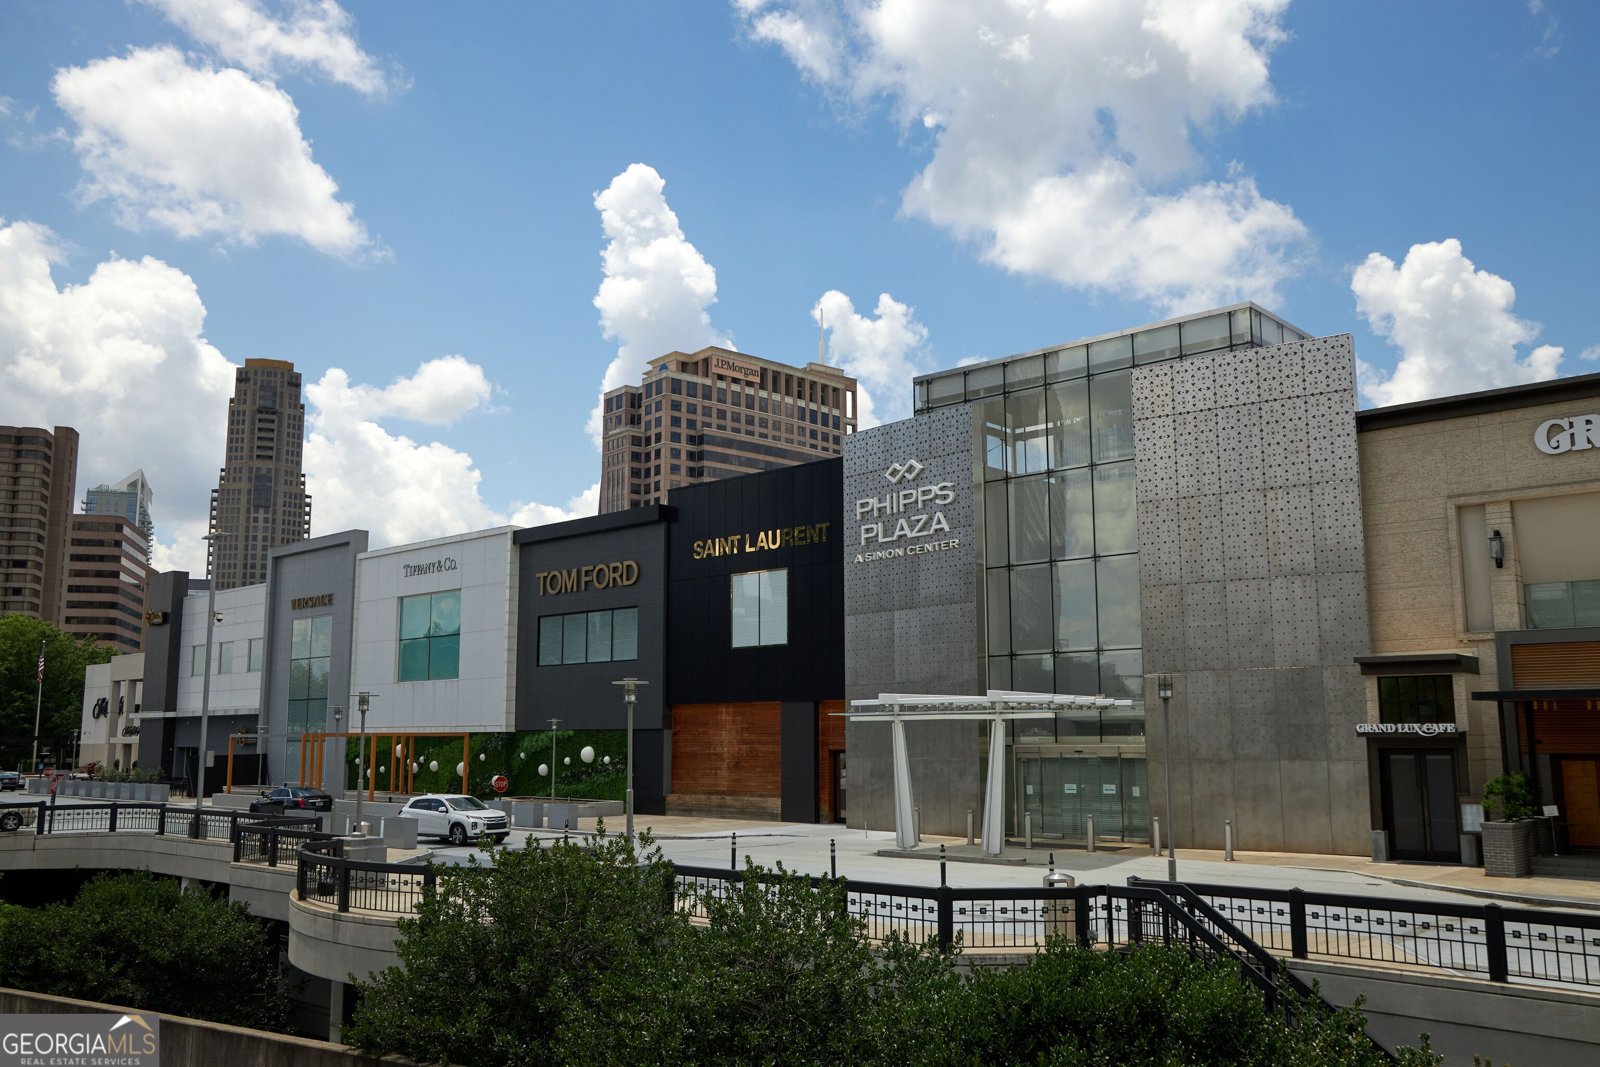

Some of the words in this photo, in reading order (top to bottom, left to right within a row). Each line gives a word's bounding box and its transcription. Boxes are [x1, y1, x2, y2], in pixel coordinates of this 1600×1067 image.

[856, 482, 956, 520] PHIPPS
[692, 535, 741, 560] SAINT
[745, 522, 831, 553] LAURENT
[861, 511, 950, 546] PLAZA
[864, 548, 905, 562] SIMON
[907, 539, 960, 555] CENTER
[535, 570, 578, 596] TOM
[581, 560, 639, 591] FORD
[1356, 723, 1396, 733] GRAND
[1397, 723, 1421, 733] LUX
